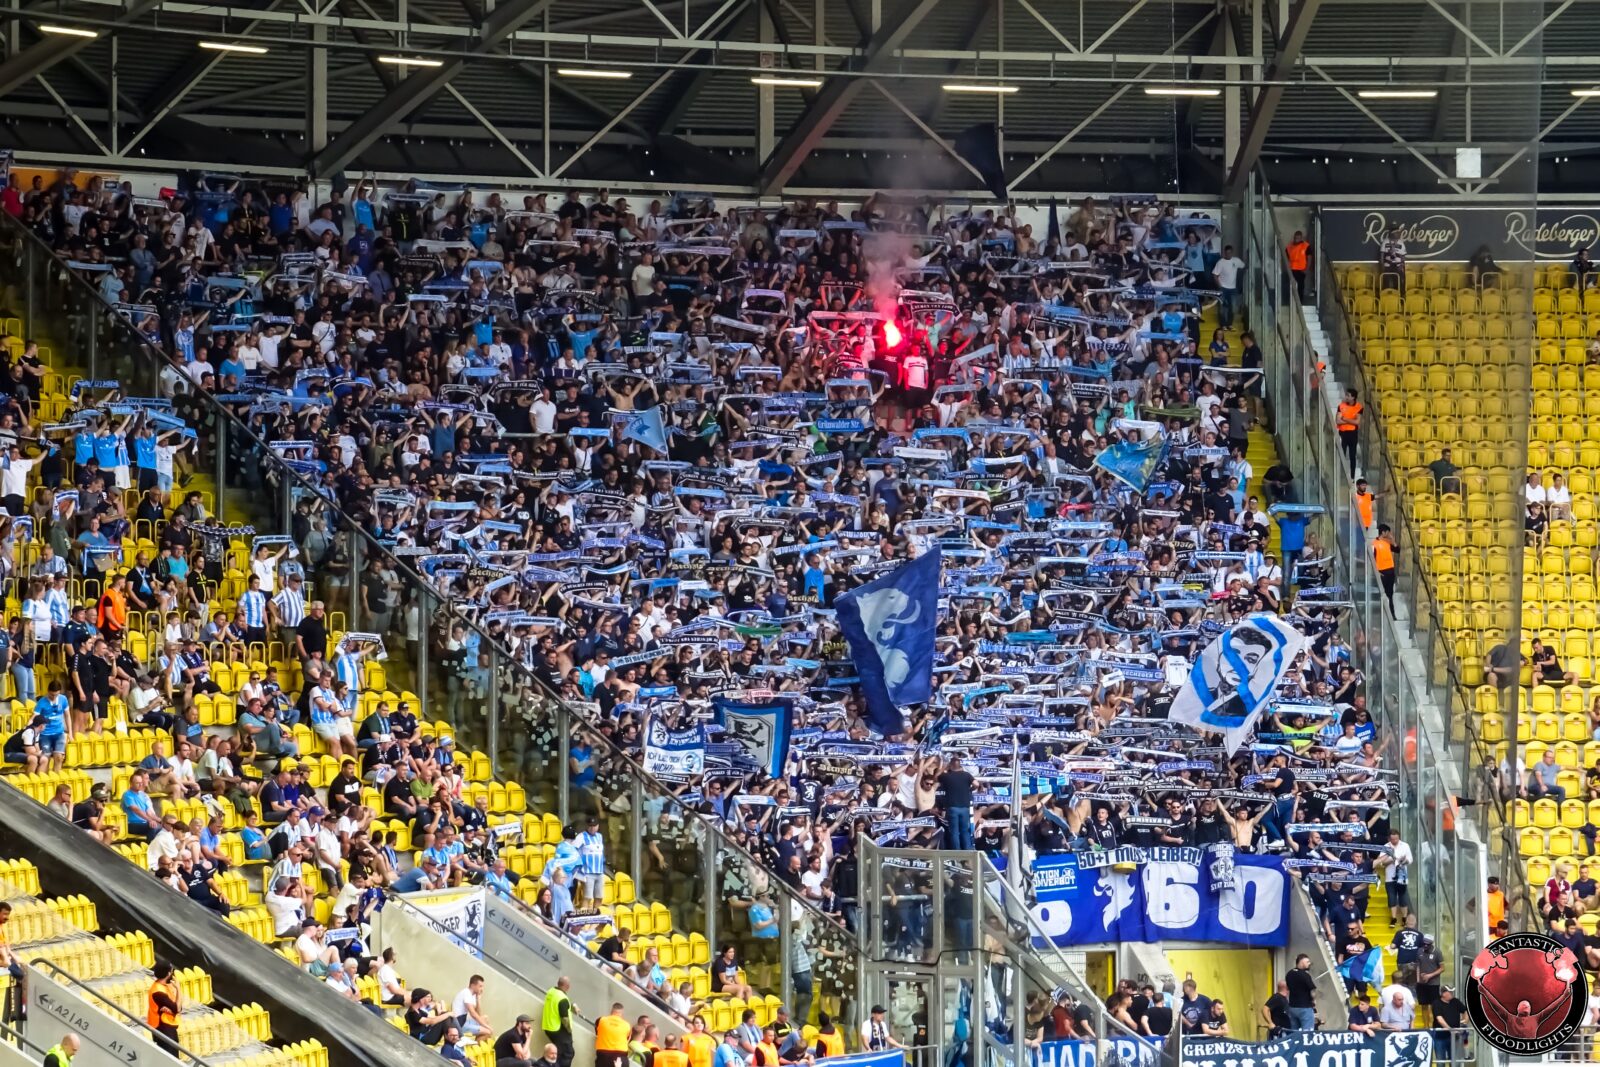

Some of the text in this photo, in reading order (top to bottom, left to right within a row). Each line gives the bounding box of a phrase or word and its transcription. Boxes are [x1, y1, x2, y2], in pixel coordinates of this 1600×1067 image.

[1362, 212, 1454, 249] Raeberger
[1503, 211, 1595, 249] Radeberger
[1033, 869, 1060, 879] KTION
[1079, 851, 1110, 869] 50+1
[1115, 846, 1143, 864] MUS
[1033, 876, 1076, 888] ONVERBOT
[501, 918, 510, 929] T2
[515, 927, 525, 939] T3
[540, 945, 549, 955] T1
[55, 1005, 70, 1019] A2
[75, 1018, 90, 1031] A3
[109, 1040, 124, 1053] A1
